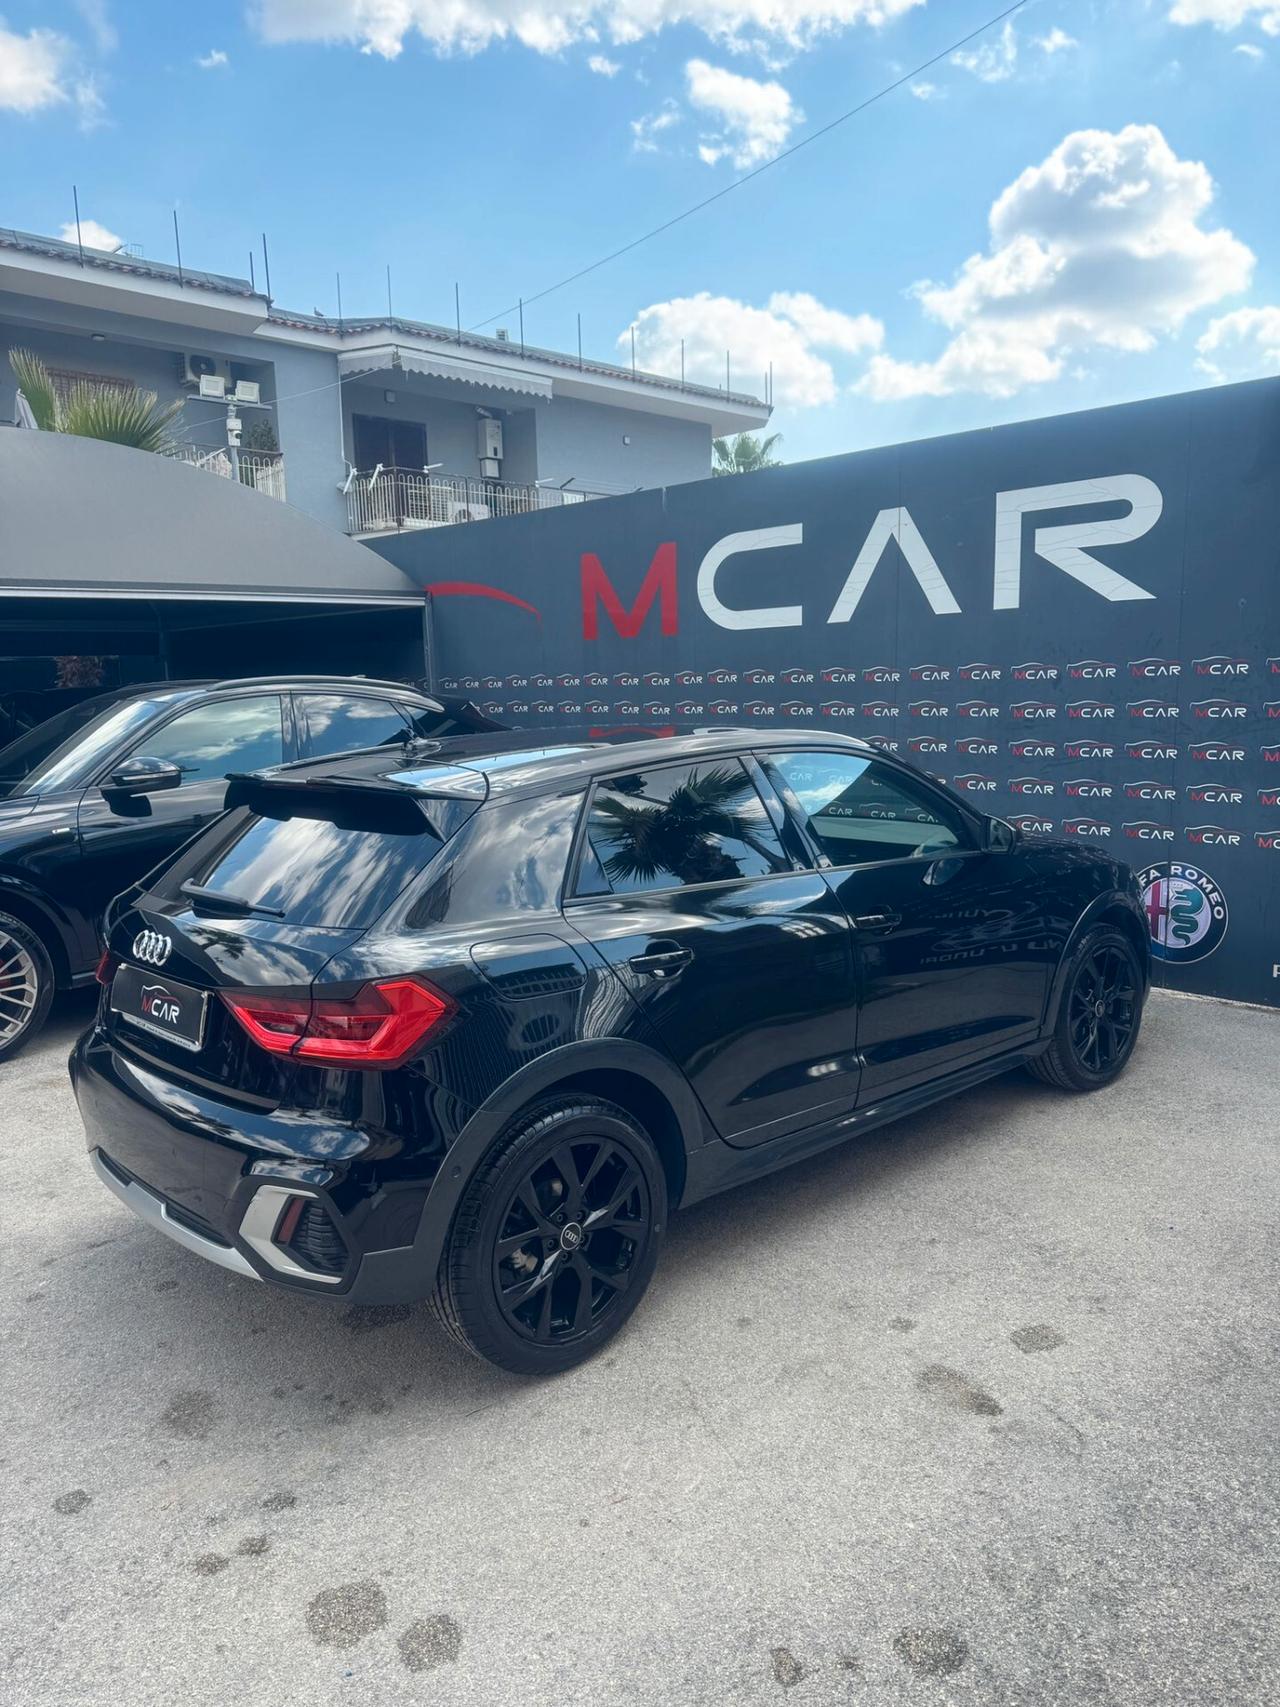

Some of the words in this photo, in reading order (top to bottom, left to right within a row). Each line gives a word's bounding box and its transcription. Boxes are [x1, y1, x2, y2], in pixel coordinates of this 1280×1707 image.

[579, 473, 1163, 641] MCAR
[961, 670, 1001, 680] MCAR
[1014, 670, 1058, 680] MCAR
[1070, 667, 1116, 678] MCAR
[1132, 665, 1181, 676] MCAR
[1196, 664, 1249, 675] MCAR
[823, 673, 856, 682] MCAR
[865, 672, 900, 682] MCAR
[912, 671, 949, 680] MCAR
[822, 707, 855, 716] MCAR
[865, 708, 899, 717] MCAR
[911, 707, 948, 716] MCAR
[960, 707, 999, 717] MCAR
[1013, 708, 1056, 718] MCAR
[1068, 707, 1115, 718] MCAR
[1130, 707, 1179, 718] MCAR
[1194, 707, 1247, 718] MCAR
[910, 743, 947, 752] MCAR
[958, 744, 998, 754] MCAR
[1012, 747, 1055, 756] MCAR
[1068, 748, 1113, 758] MCAR
[1128, 748, 1177, 760] MCAR
[1192, 749, 1244, 761] MCAR
[956, 780, 996, 791] MCAR
[1011, 784, 1054, 795] MCAR
[1066, 786, 1112, 798] MCAR
[1127, 788, 1176, 800] MCAR
[1190, 791, 1243, 804] MCAR
[1065, 825, 1111, 837] MCAR
[1126, 828, 1174, 841] MCAR
[1188, 833, 1240, 846] MCAR
[1170, 865, 1224, 919] ROMEO
[141, 995, 180, 1024] MCAR
